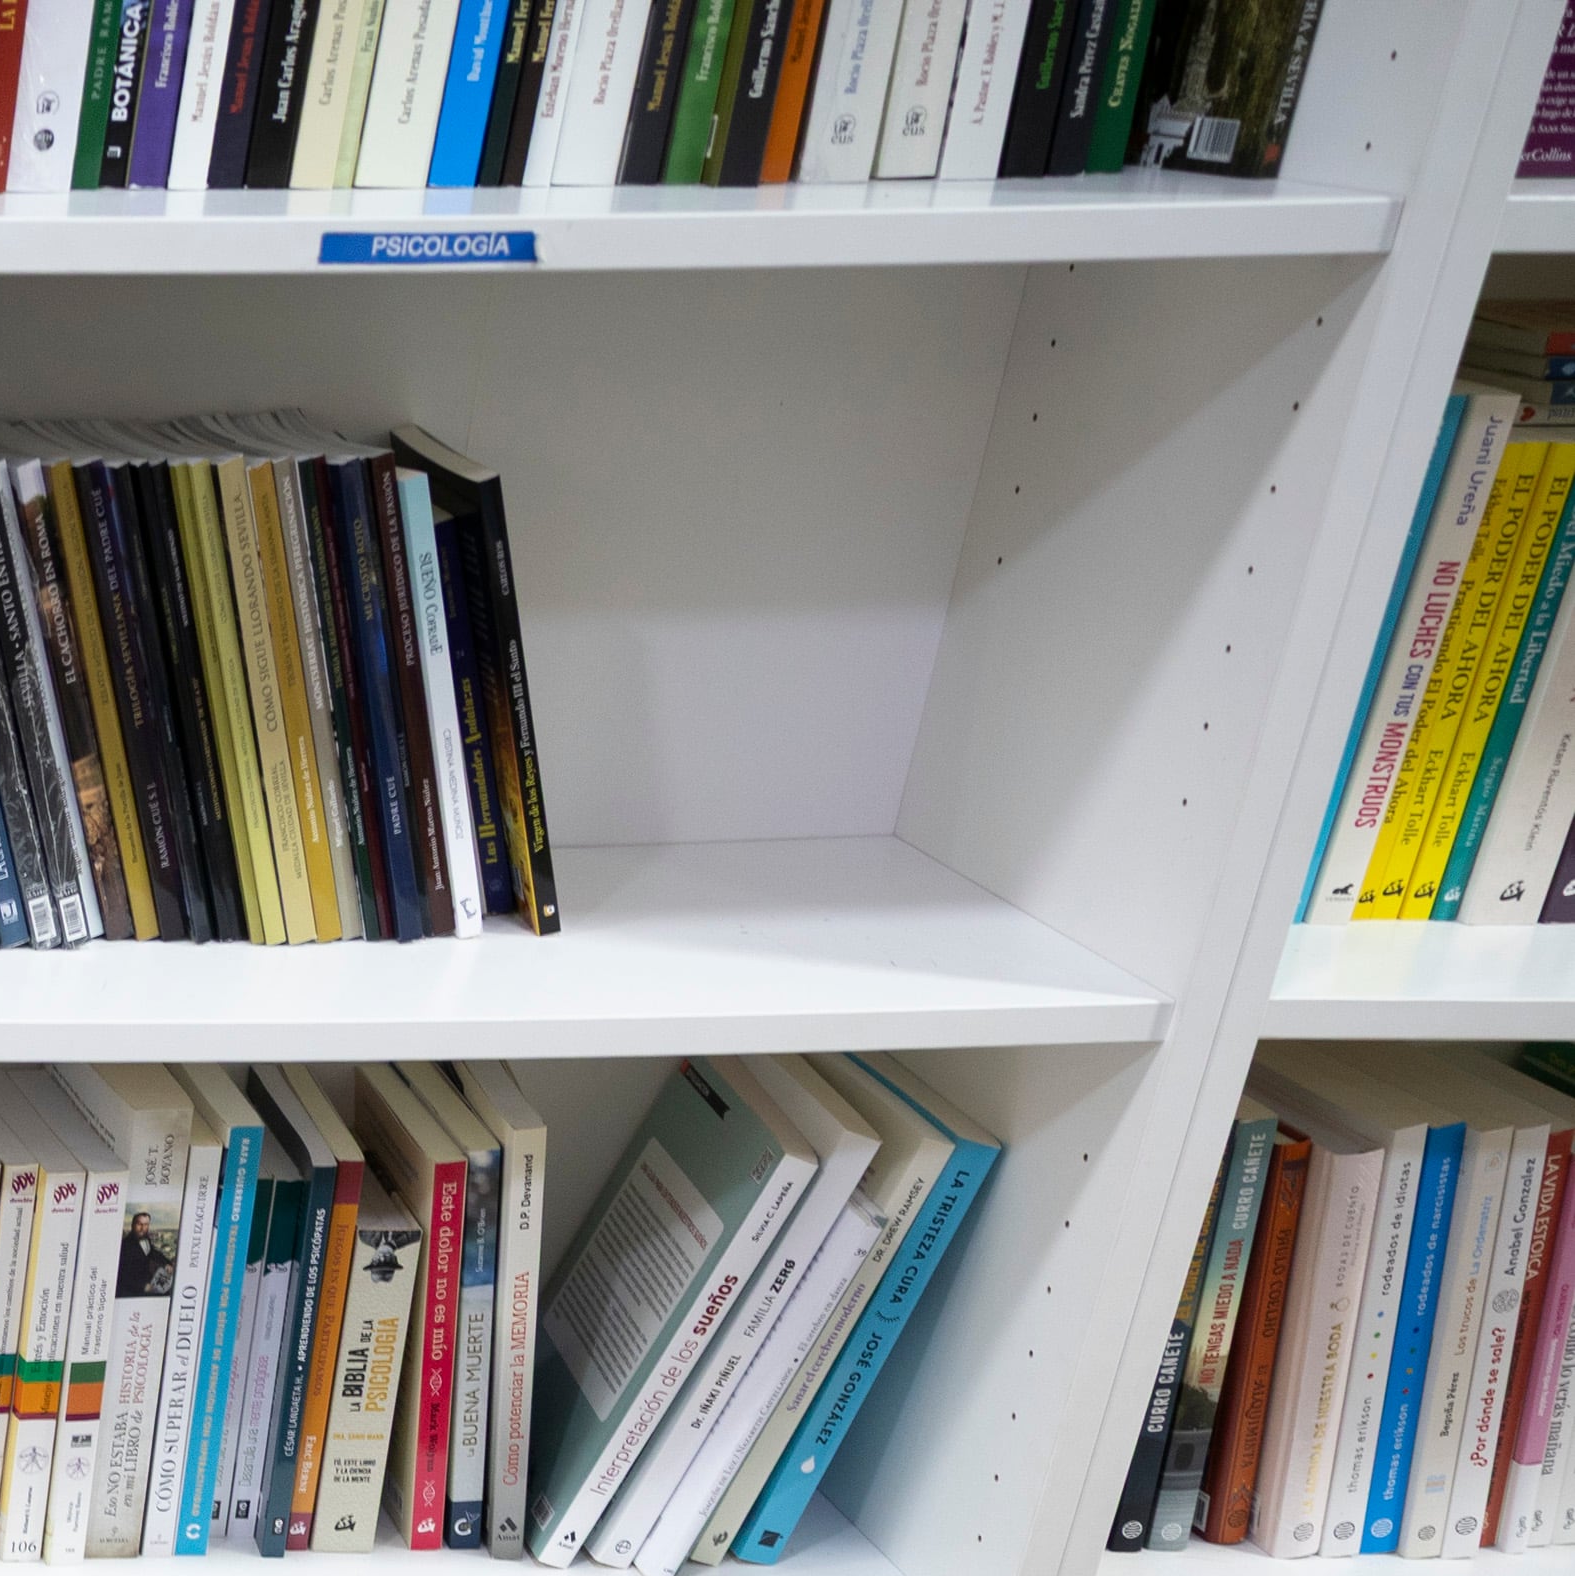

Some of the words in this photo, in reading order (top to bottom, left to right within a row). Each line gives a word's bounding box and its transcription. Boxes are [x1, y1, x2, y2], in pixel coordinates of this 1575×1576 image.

[111, 1, 145, 123] BOTÁNICA
[371, 234, 510, 258] PSICOLOGÍA
[1476, 414, 1496, 468] Juani
[1455, 468, 1485, 527] Ureña
[1509, 473, 1535, 505] EL
[1488, 507, 1521, 585] PODER
[1437, 561, 1462, 588] NO
[1408, 585, 1451, 660] LUCHES
[1467, 589, 1499, 636] DEL
[1405, 664, 1425, 692] CON
[1439, 640, 1482, 722] AHORA
[1393, 692, 1411, 719] TUS
[1354, 722, 1409, 830] MONSTRUOS
[949, 1170, 971, 1189] LA
[1241, 1131, 1266, 1183] CAÑETE
[439, 1181, 457, 1223] Este
[913, 1189, 959, 1262] TRISTEZA
[1232, 1186, 1254, 1232] CURRO
[1503, 1231, 1521, 1277] Anabel
[1512, 1157, 1537, 1223] Gonzalez
[434, 1224, 455, 1273] dolor
[434, 1279, 448, 1299] no
[692, 1273, 739, 1337] sueños
[889, 1264, 920, 1305] CURA
[433, 1304, 447, 1323] es
[510, 1271, 530, 1349] MEMORIA
[365, 1317, 400, 1412] PSICOLOGIA
[431, 1326, 449, 1362] mío
[466, 1311, 484, 1381] MUERTE
[509, 1350, 525, 1367] la
[670, 1339, 700, 1366] los
[855, 1332, 883, 1371] JOSÉ
[342, 1347, 369, 1397] BIBLIA
[660, 1366, 682, 1388] de
[462, 1391, 480, 1448] BUENA
[508, 1369, 525, 1441] potenciar
[816, 1371, 864, 1446] GONZÁLEZ
[502, 1443, 521, 1487] Cómo
[590, 1390, 668, 1498] Interpretación
